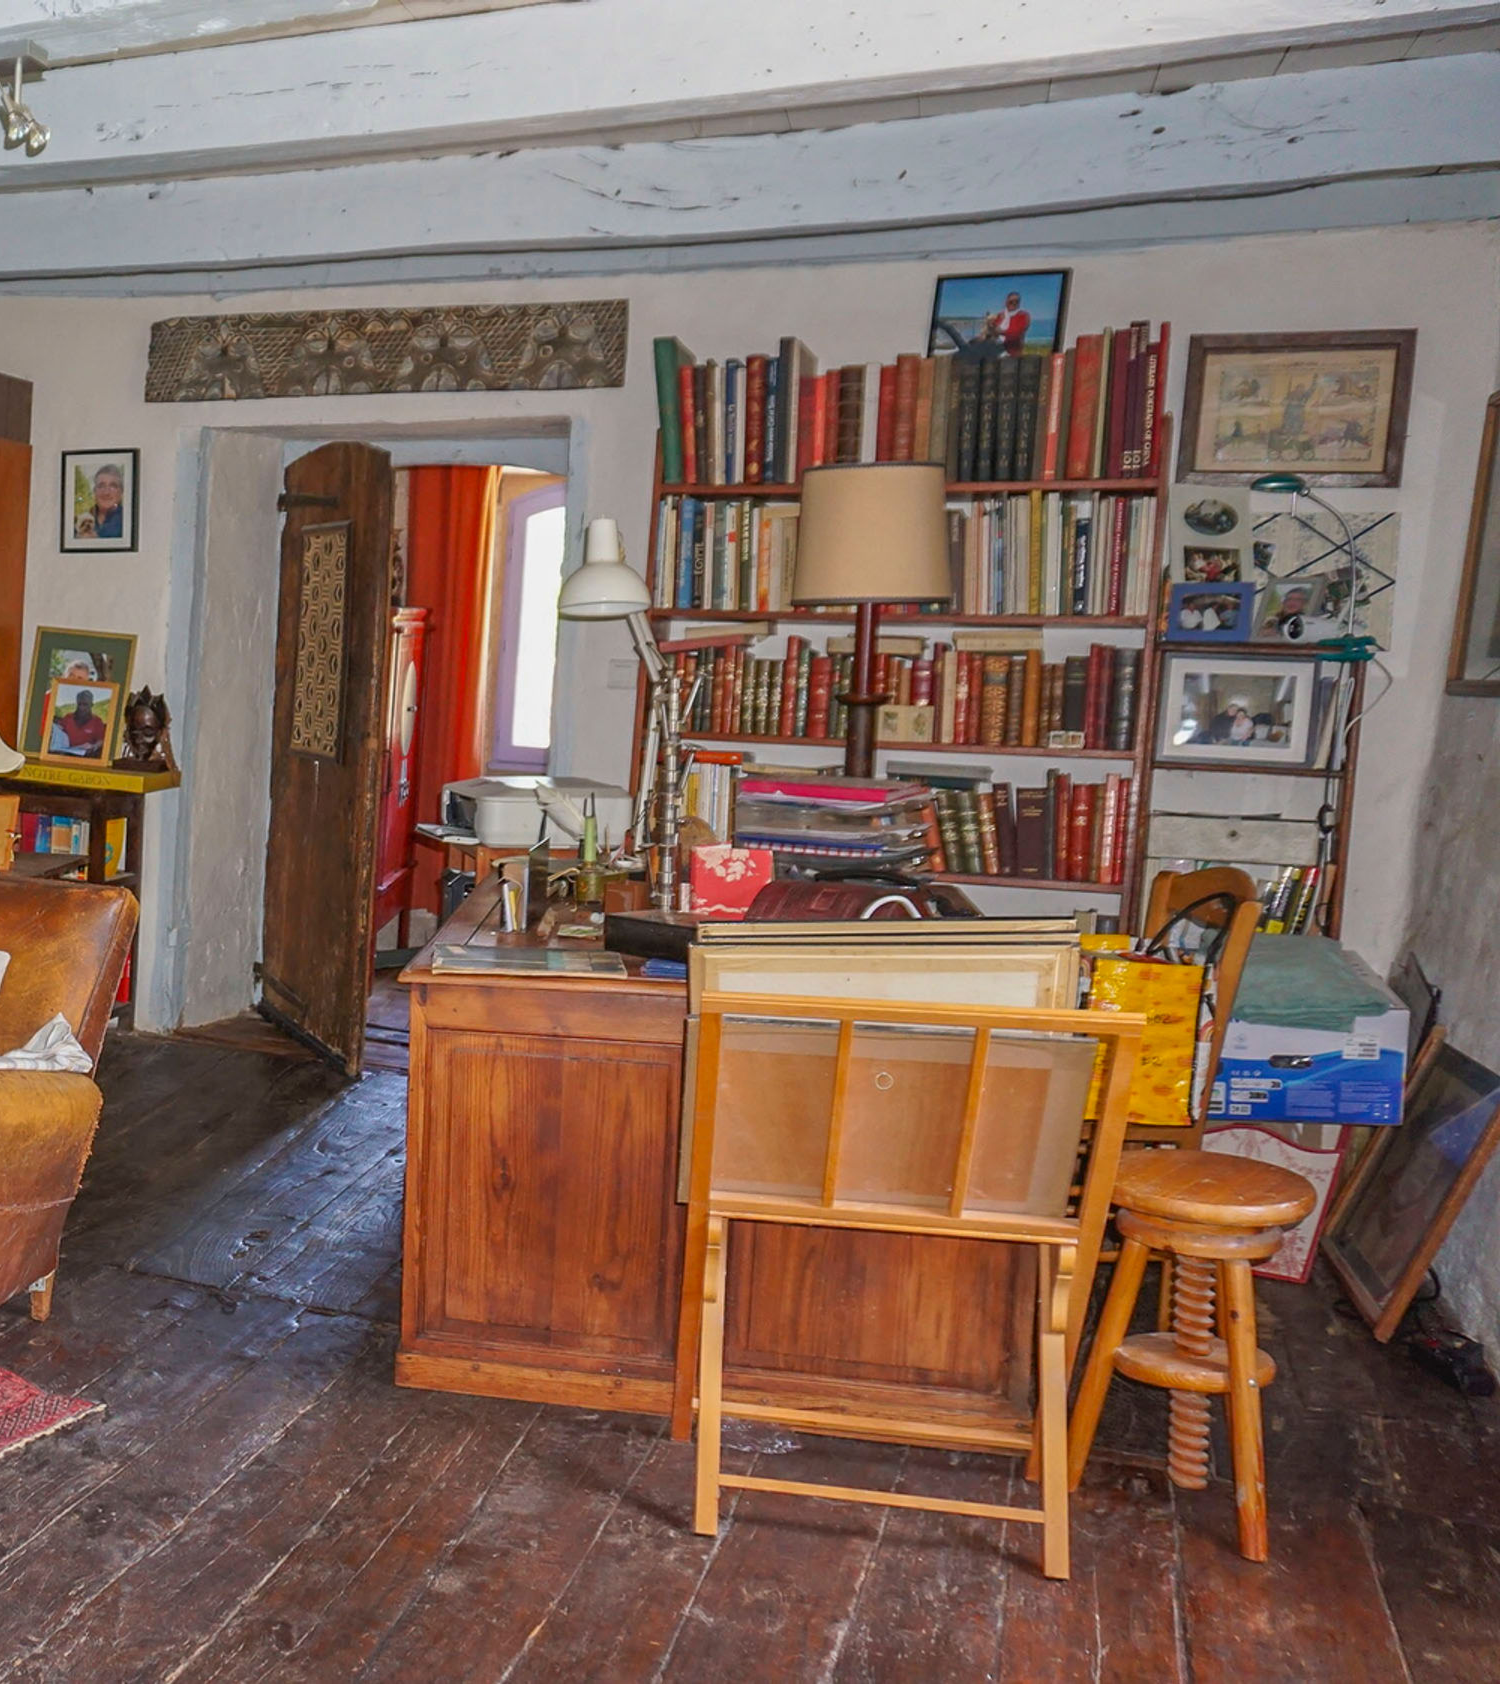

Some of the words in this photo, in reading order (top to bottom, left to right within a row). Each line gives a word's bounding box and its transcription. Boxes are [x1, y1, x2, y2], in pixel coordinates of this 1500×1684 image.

[1148, 354, 1158, 387] LITERARY
[1145, 389, 1155, 429] PORTRAITS
[1145, 430, 1152, 440] OF
[1143, 441, 1152, 466] CHINA
[23, 766, 62, 781] NOTRE
[67, 772, 111, 786] GABON
